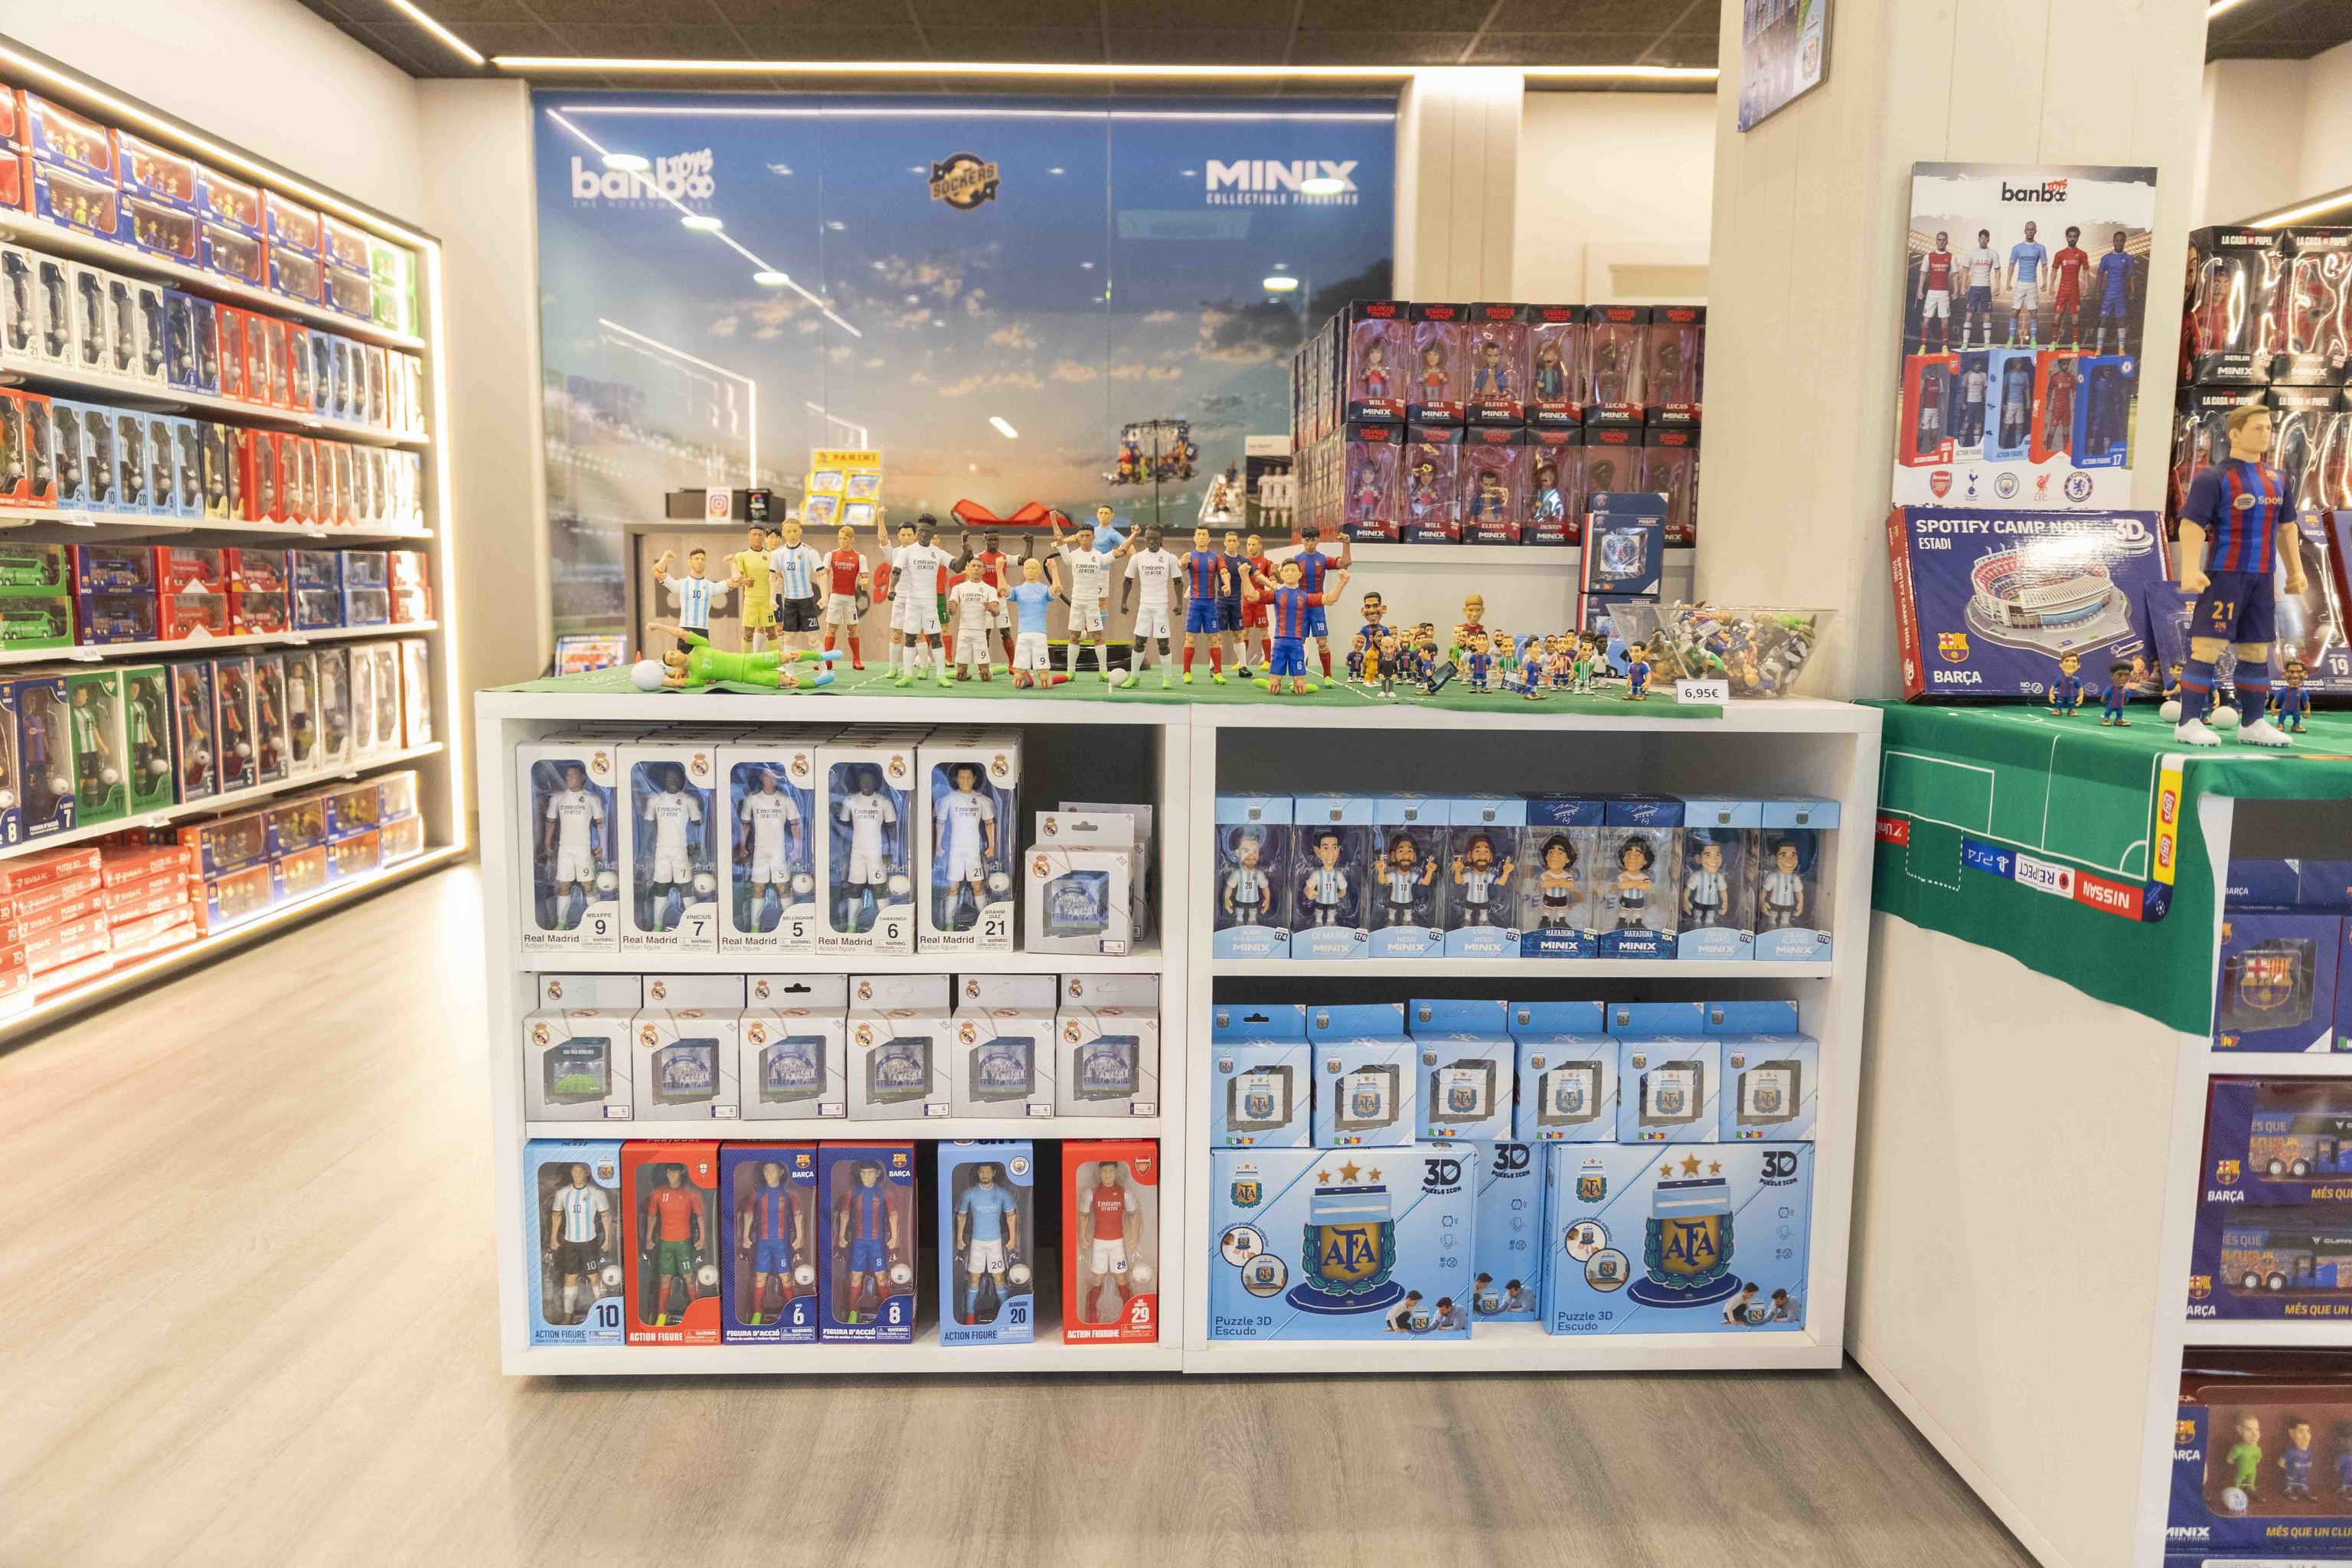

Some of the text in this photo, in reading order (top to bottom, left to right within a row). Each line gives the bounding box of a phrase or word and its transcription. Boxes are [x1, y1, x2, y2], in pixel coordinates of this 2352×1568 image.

[933, 165, 994, 197] SOCKERS
[1206, 159, 1359, 191] MINIX
[2047, 178, 2068, 191] TOYS
[1206, 193, 1286, 204] COLLECTIBLE
[2222, 236, 2230, 244] LA
[2231, 236, 2246, 244] CASA
[2256, 237, 2272, 245] PAPEL
[2330, 237, 2347, 246] PAPEL
[2203, 397, 2210, 405] LA
[832, 453, 876, 462] PANINI
[2112, 454, 2122, 465] 17
[77, 489, 84, 501] 24
[1916, 520, 2047, 534] SPOTIFY CAMP
[2112, 519, 2145, 540] 3D
[1919, 537, 1951, 550] ESTADI
[787, 561, 795, 570] 20
[692, 590, 701, 599] 10
[2212, 600, 2234, 620] 21
[808, 618, 818, 626] 20
[929, 619, 935, 629] 7
[1160, 625, 1165, 633] 6
[2329, 658, 2349, 675] 19
[1934, 671, 1982, 686] BARÇA
[1684, 688, 1719, 699] 6,95€
[64, 809, 71, 828] 7
[8, 822, 17, 842] 8
[1968, 849, 1994, 866] PS4
[2019, 861, 2054, 884] REPECT
[2082, 880, 2129, 909] NISSAN
[595, 920, 606, 934] 9
[693, 922, 704, 936] 7
[792, 923, 803, 936] 5
[887, 923, 898, 938] 6
[985, 921, 1005, 935] 21
[524, 934, 579, 942] Real Madrid
[623, 936, 678, 944] Real Madrid
[818, 937, 838, 946] Real
[841, 937, 872, 946] Madrid
[920, 936, 974, 944] Real Madrid
[1661, 933, 1672, 942] 10A
[1493, 1144, 1530, 1169] 3D
[1762, 1152, 1798, 1178] 3D
[1423, 1160, 1461, 1185] 3D
[1237, 1184, 1256, 1200] AFA
[1421, 1186, 1445, 1194] PUZZLE
[2208, 1190, 2244, 1202] BARÇA
[2311, 1186, 2332, 1199] MÉS
[573, 1204, 581, 1213] 10
[1663, 1220, 1716, 1266] AFA
[1322, 1227, 1376, 1272] AFA
[586, 1261, 596, 1270] 10
[682, 1261, 691, 1269] 11
[991, 1261, 1002, 1269] 20
[1117, 1261, 1125, 1269] 29
[889, 1306, 900, 1323] 8
[2186, 1305, 2216, 1317] ARÇA
[2285, 1302, 2348, 1315] MÉS QUE UN
[596, 1305, 619, 1327] 10
[793, 1309, 804, 1324] 6
[1011, 1308, 1026, 1323] 20
[1132, 1307, 1149, 1323] 29
[1558, 1312, 1613, 1322] Puzzle 3D
[1216, 1316, 1272, 1327] Puzzle 3D
[1557, 1321, 1598, 1331] Escudo
[629, 1332, 656, 1341] ACTION
[658, 1332, 682, 1341] FIGURE
[945, 1331, 969, 1340] ACTION
[972, 1331, 997, 1339] FIGURE
[1092, 1329, 1119, 1338] FIGURINE
[1215, 1327, 1256, 1335] Escudo
[2266, 1524, 2288, 1537] MÉS
[2291, 1527, 2312, 1537] QUE
[2314, 1527, 2329, 1537] UN
